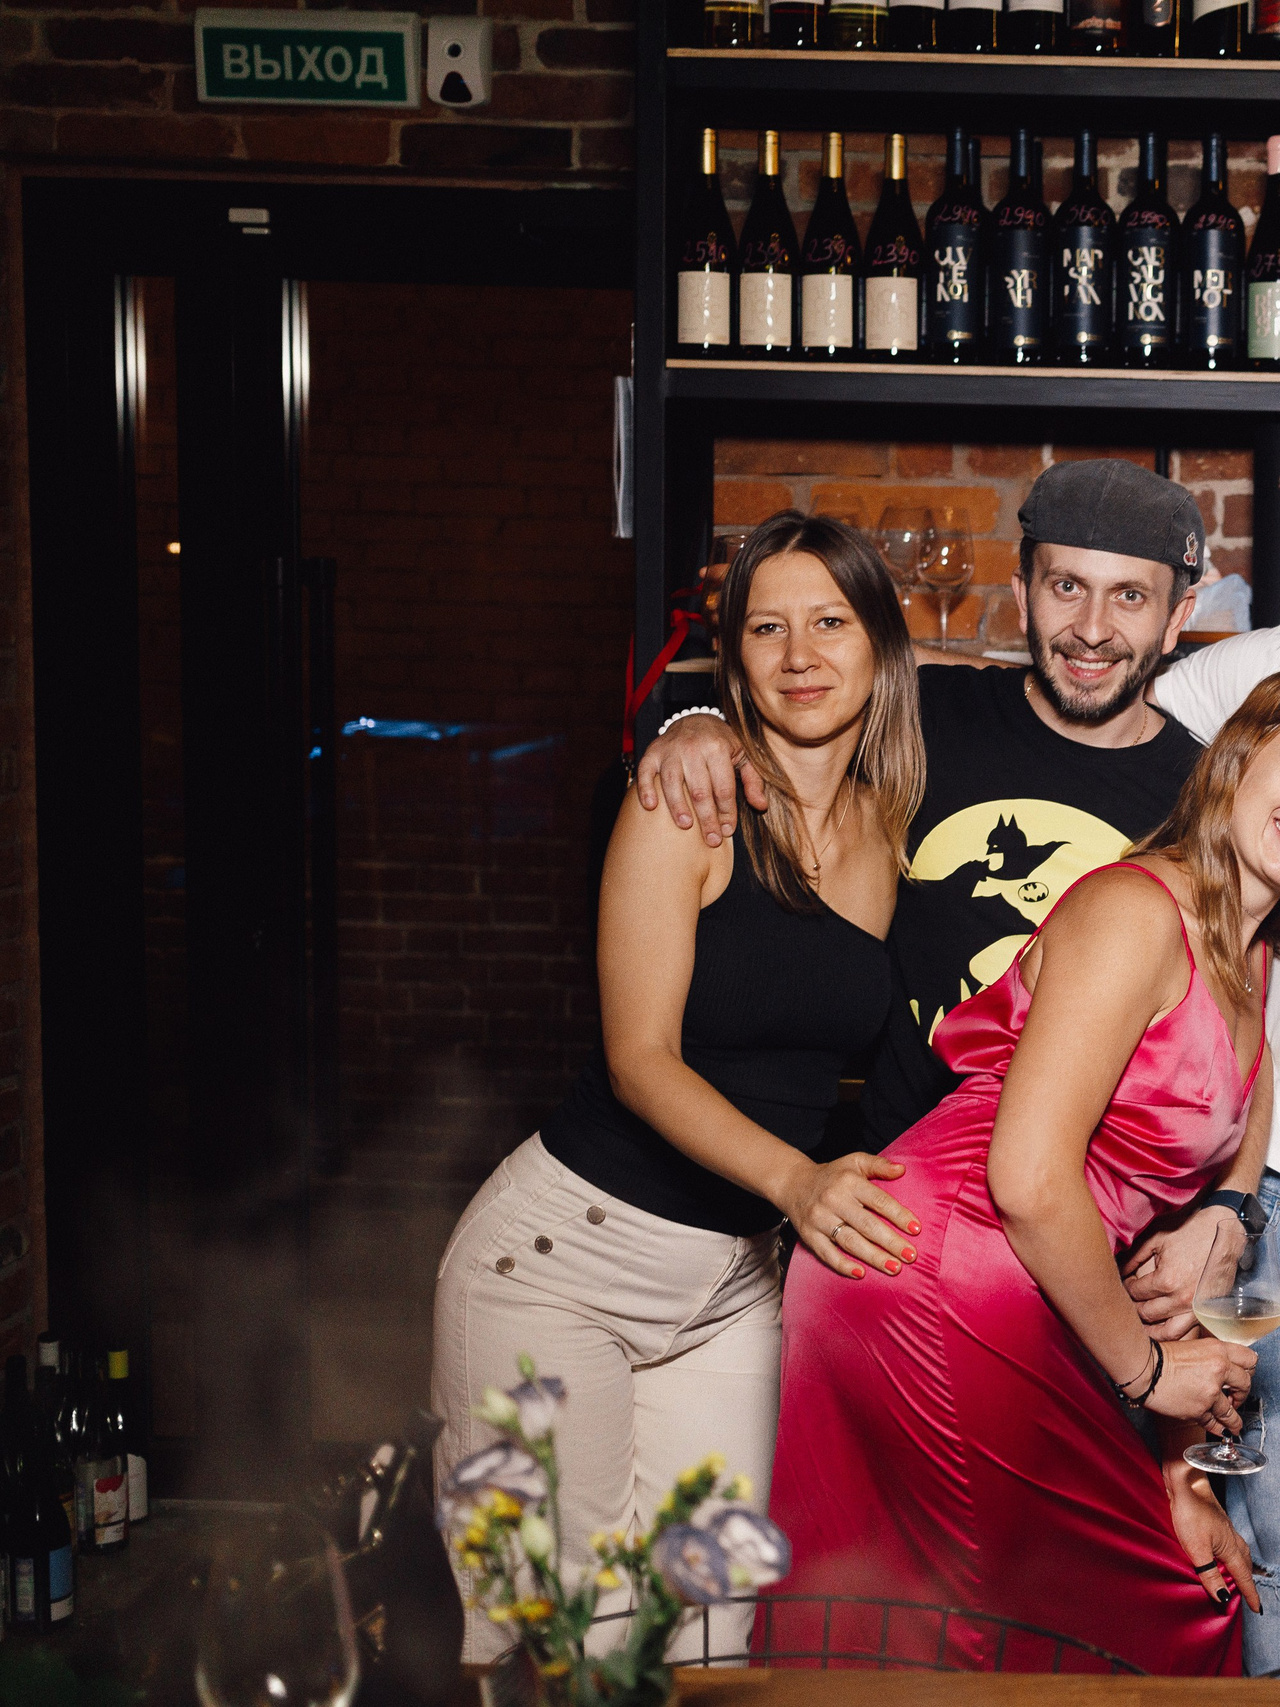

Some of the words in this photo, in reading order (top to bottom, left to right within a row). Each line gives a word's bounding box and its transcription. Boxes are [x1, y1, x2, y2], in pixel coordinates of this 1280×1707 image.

[221, 43, 389, 89] ВЫХОД
[998, 206, 1045, 227] 2990
[872, 244, 920, 266] 2390
